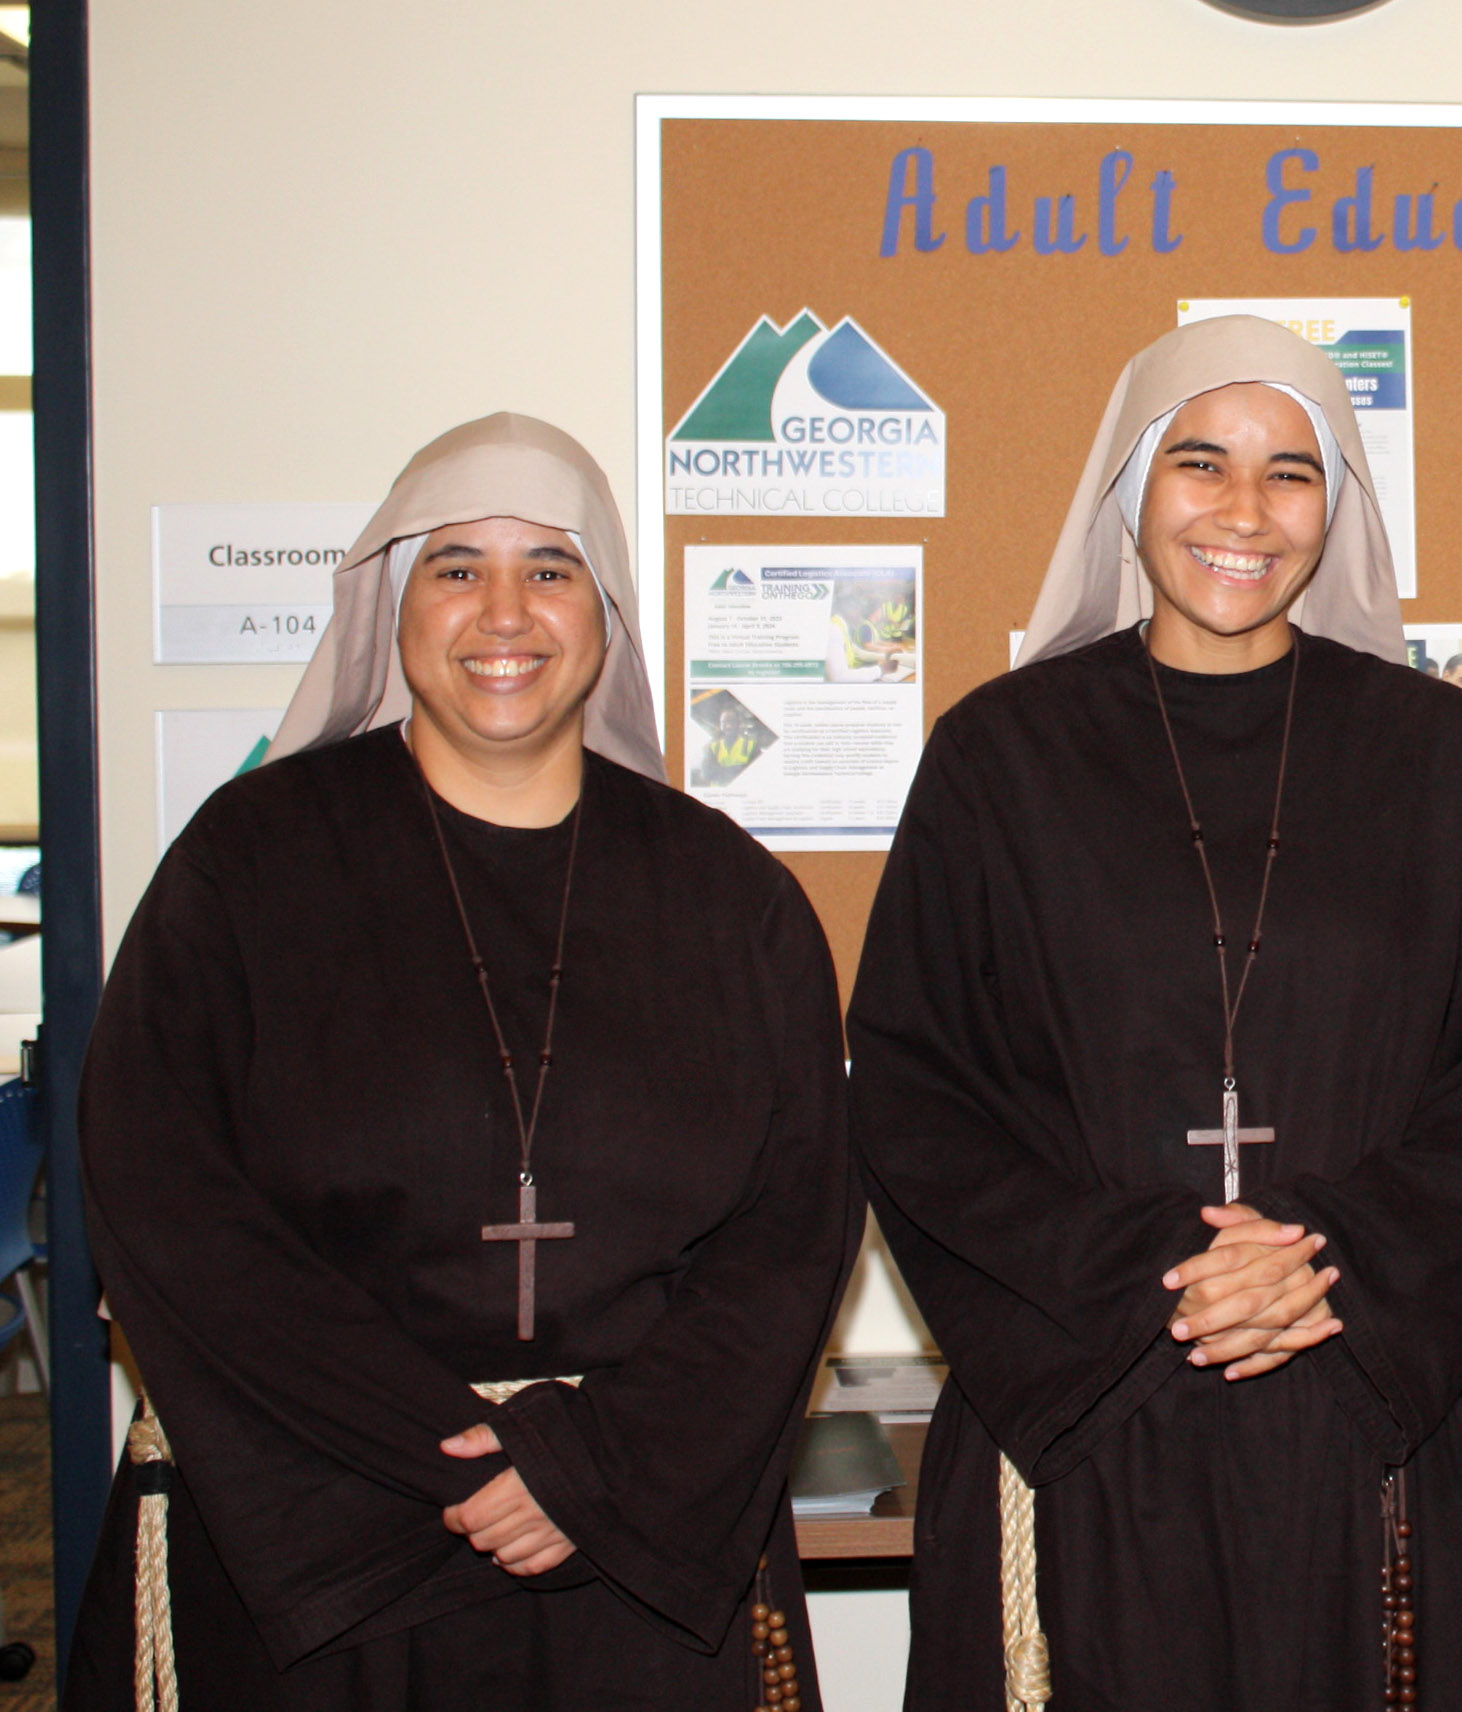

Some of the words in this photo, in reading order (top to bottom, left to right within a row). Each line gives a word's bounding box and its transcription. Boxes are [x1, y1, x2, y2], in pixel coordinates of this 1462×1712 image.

[880, 146, 1185, 258] Adult
[1276, 320, 1336, 342] REE
[1345, 377, 1378, 392] nters
[1351, 396, 1373, 406] sses
[781, 417, 939, 445] GEORGIA
[669, 449, 938, 478] NORTHWESTERN
[670, 487, 815, 511] TECHNICAL
[822, 488, 938, 513] COLLEGE
[208, 544, 346, 567] Classroom
[761, 584, 810, 593] TRAINING
[240, 615, 316, 635] A-104
